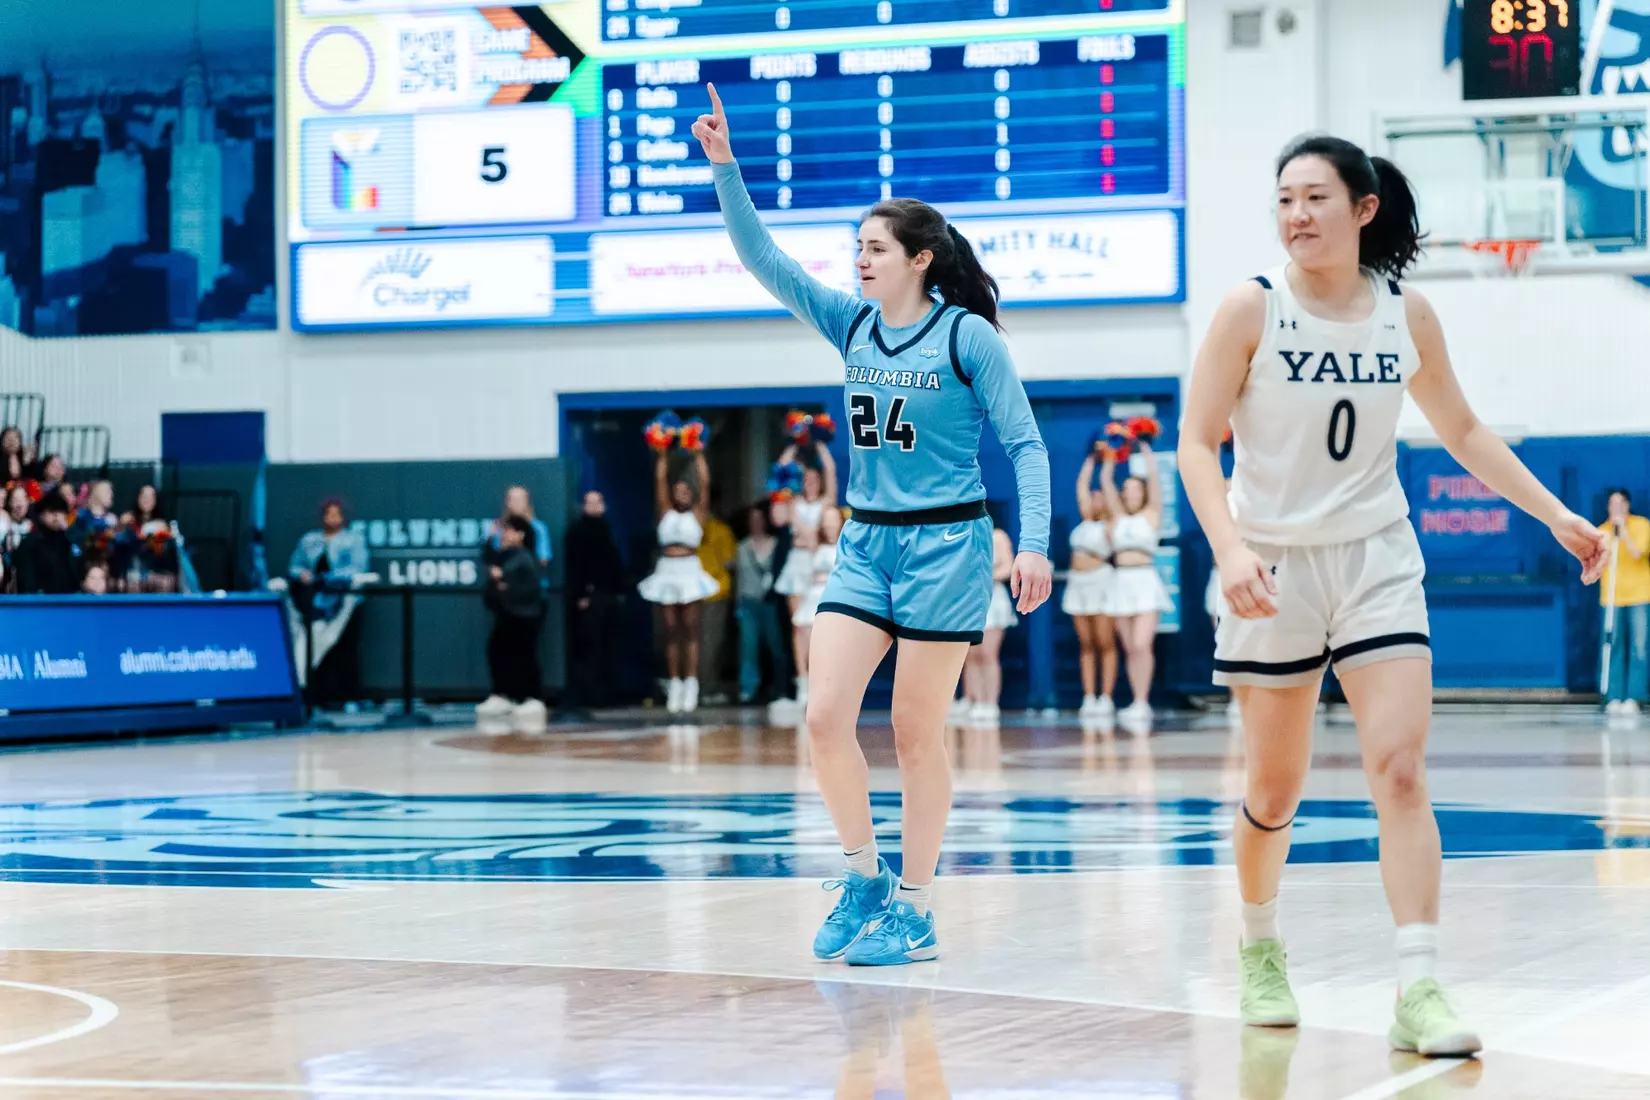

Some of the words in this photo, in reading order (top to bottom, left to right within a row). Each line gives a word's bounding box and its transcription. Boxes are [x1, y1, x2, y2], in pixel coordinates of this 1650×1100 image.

[1491, 0, 1568, 33] 8:37
[481, 147, 507, 183] 5
[977, 230, 1037, 256] MITY
[846, 366, 941, 390] COLUMBIA
[1278, 351, 1401, 383] YALE
[850, 392, 916, 452] 24
[1327, 399, 1356, 461] 0
[350, 518, 494, 546] COLUMBI
[1420, 508, 1509, 534] HOSE
[388, 560, 477, 585] LIONS
